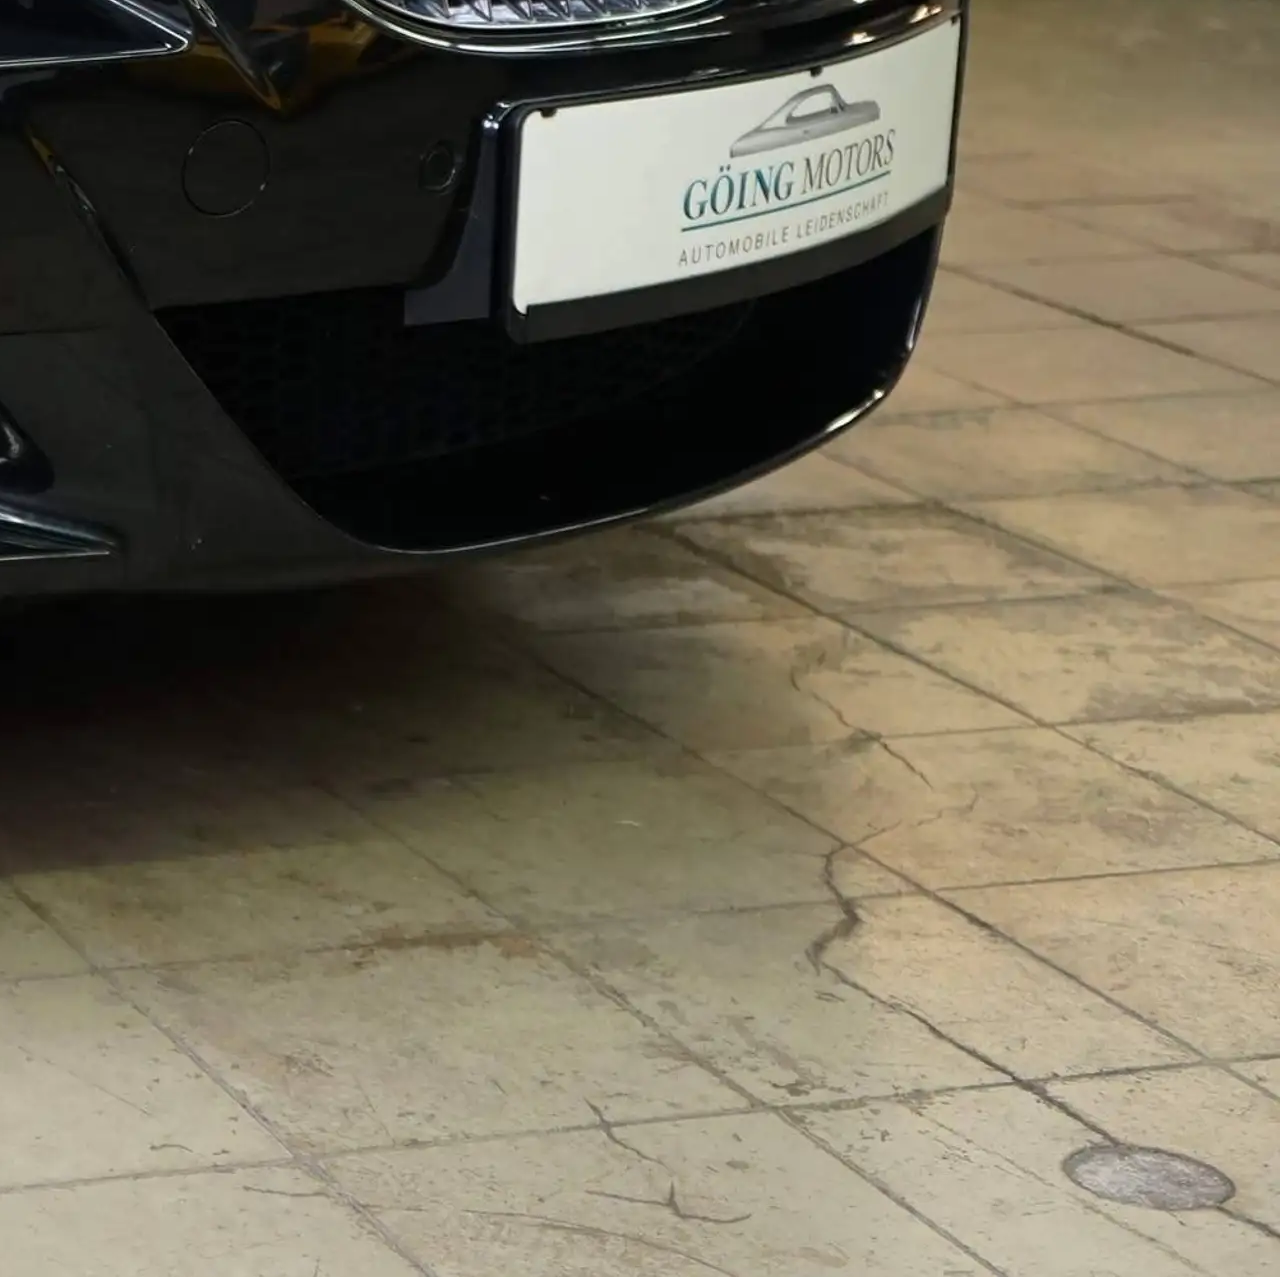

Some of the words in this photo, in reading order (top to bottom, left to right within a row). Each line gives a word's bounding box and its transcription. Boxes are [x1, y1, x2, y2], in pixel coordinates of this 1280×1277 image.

[682, 162, 795, 221] GÖING
[800, 129, 897, 196] MOTORS
[677, 226, 790, 267] AUTOMOBILE
[795, 191, 890, 240] LEIDENSCHAFT
